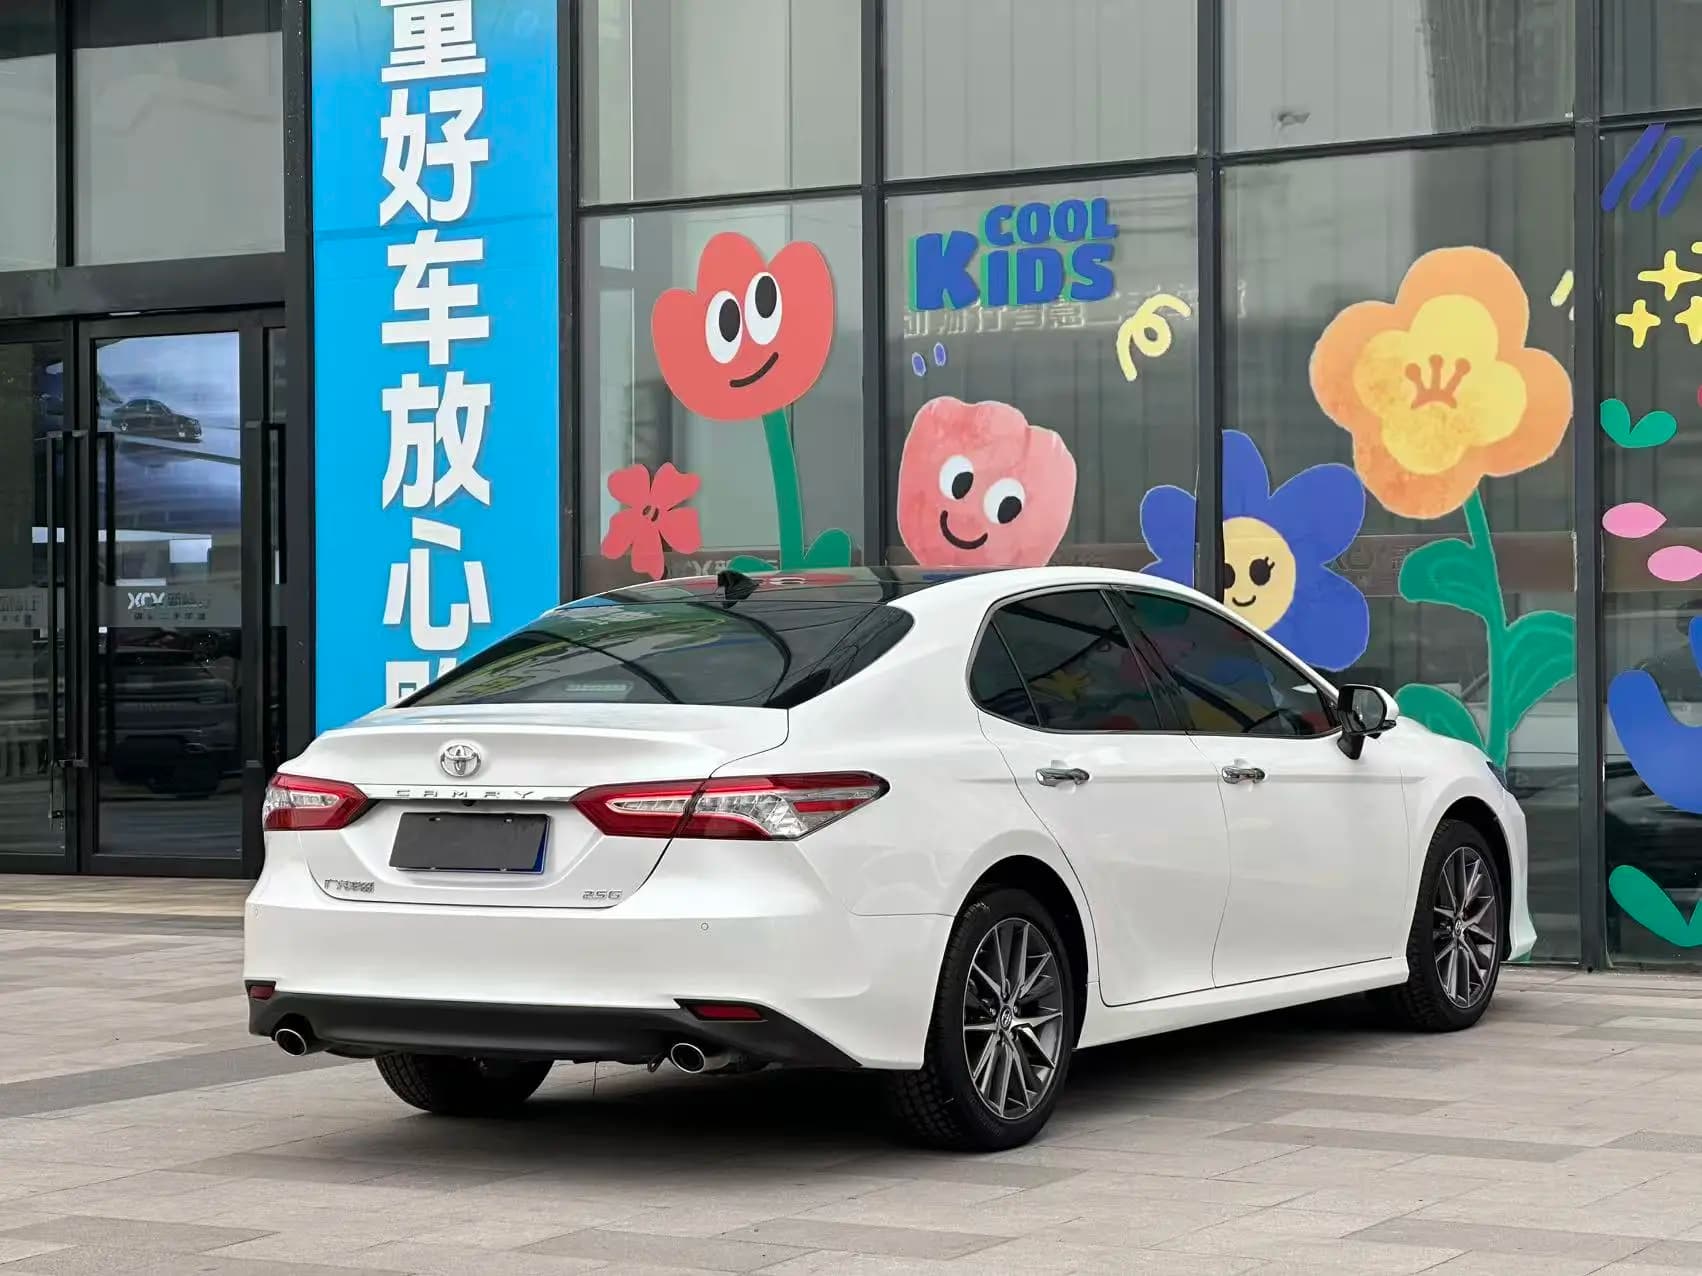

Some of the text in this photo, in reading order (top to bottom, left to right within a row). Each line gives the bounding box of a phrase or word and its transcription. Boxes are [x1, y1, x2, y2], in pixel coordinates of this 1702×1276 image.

[979, 197, 1119, 248] COOL
[908, 230, 1116, 312] KIDS
[379, 0, 492, 706] 量好车放心
[396, 789, 534, 799] CAMRY
